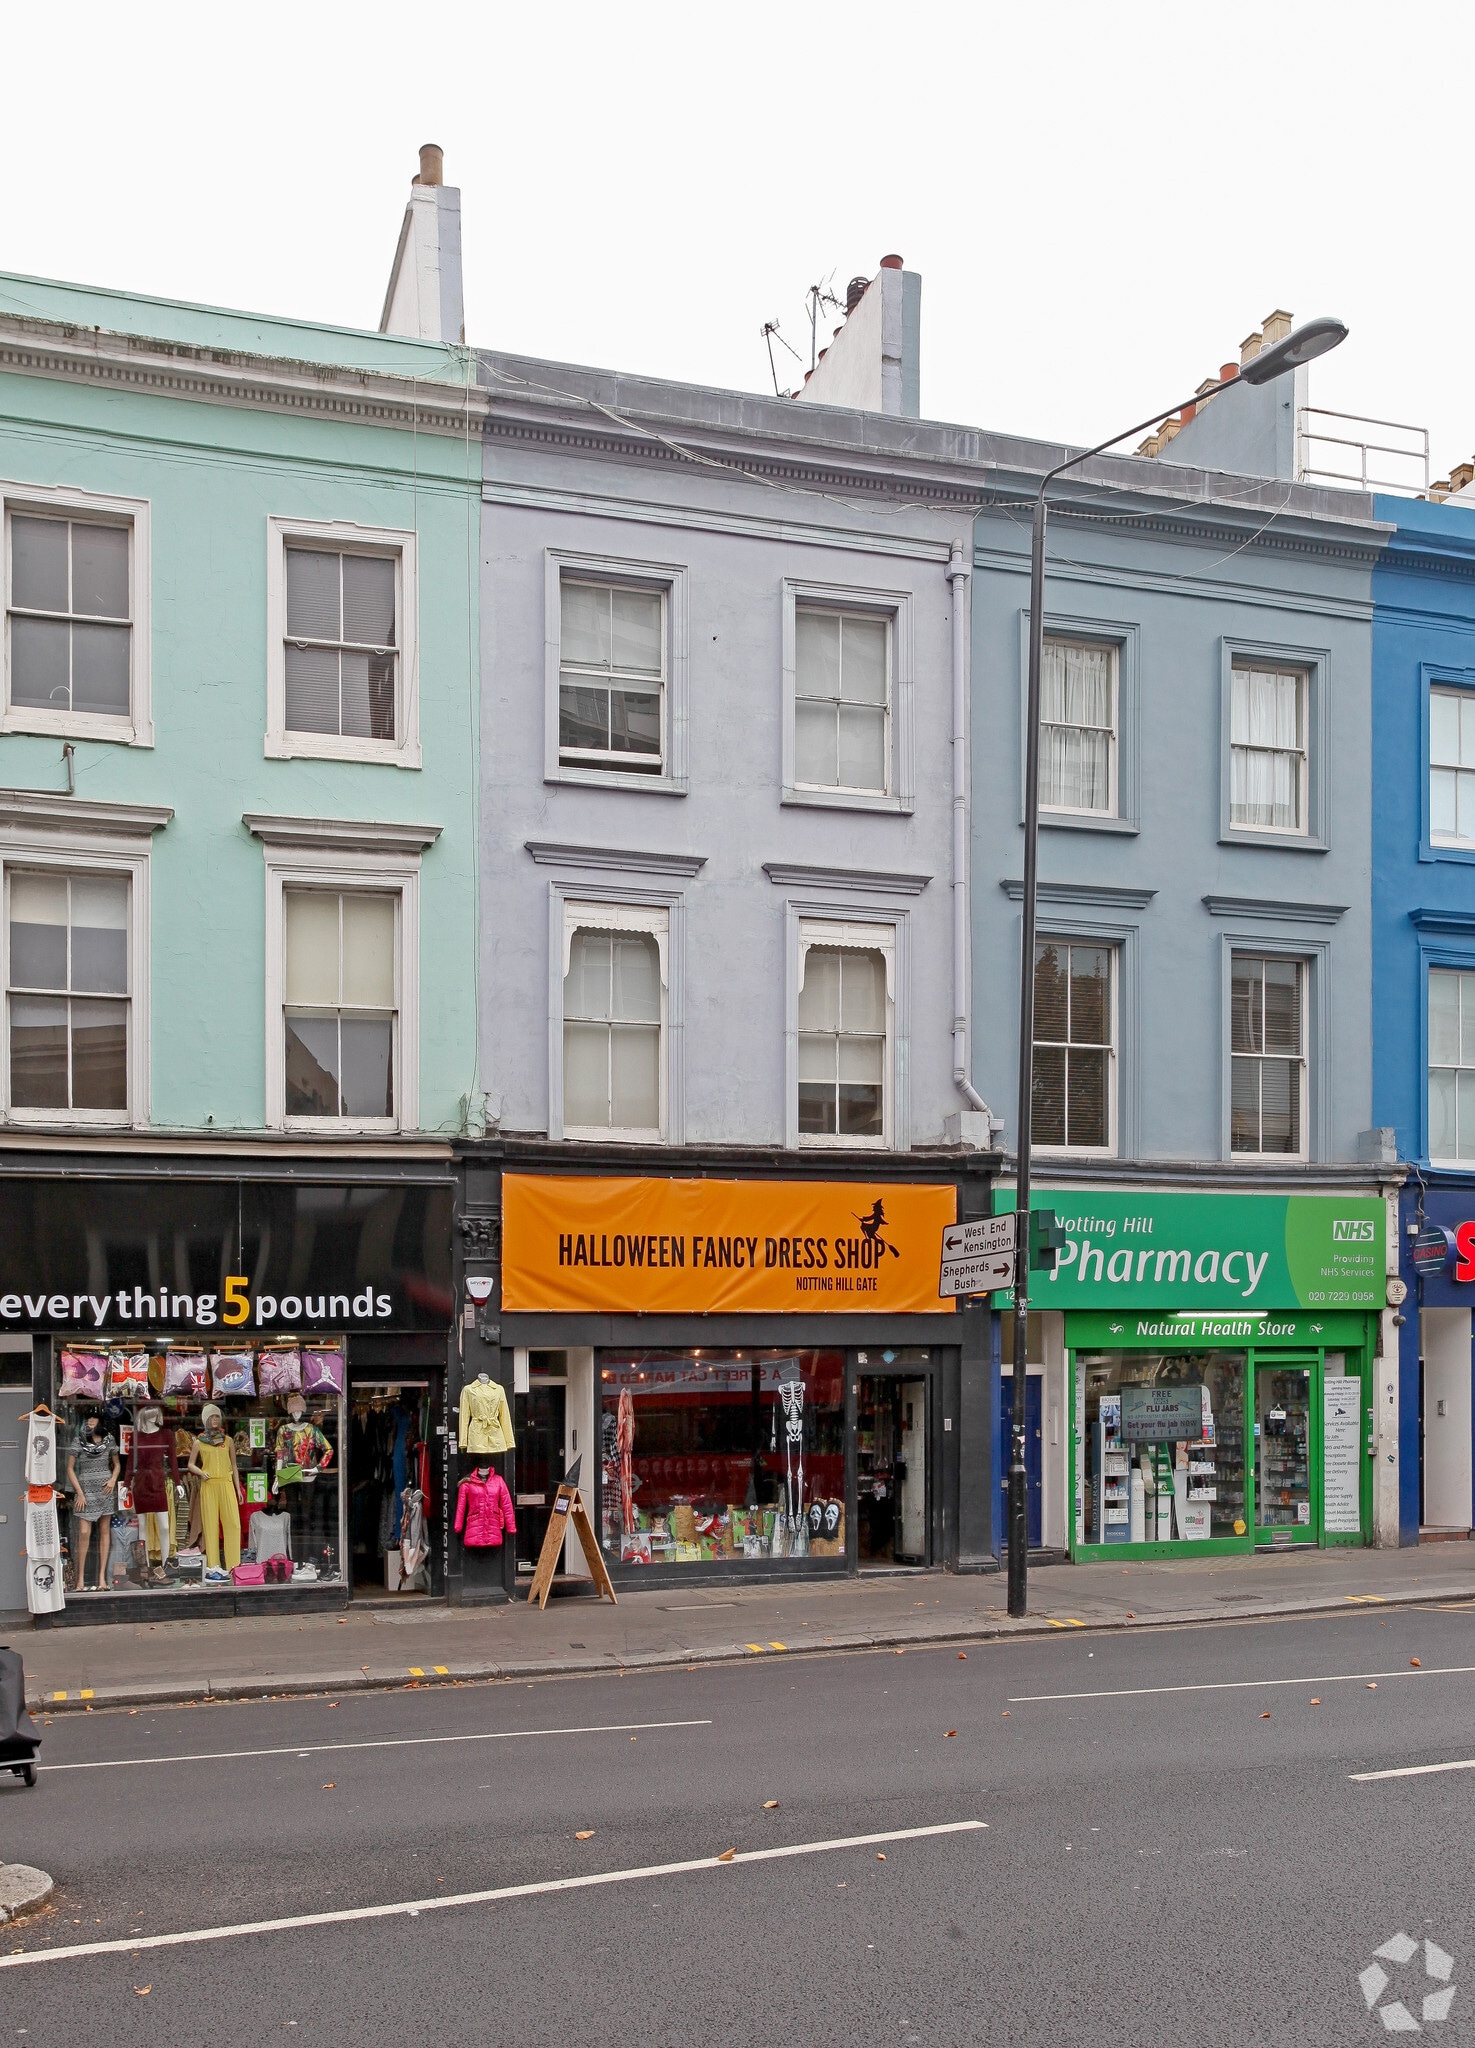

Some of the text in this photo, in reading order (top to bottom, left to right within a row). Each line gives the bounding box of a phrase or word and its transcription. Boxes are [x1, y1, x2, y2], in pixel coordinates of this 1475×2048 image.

[964, 1220, 1006, 1239] West End
[1055, 1216, 1153, 1238] Notting Hill
[1334, 1221, 1374, 1240] NHS
[558, 1233, 887, 1269] HALLOWEEN FANCY DRESS SHOP
[963, 1236, 1011, 1253] Kensington
[1413, 1245, 1448, 1260] CASINO
[1333, 1254, 1374, 1265] Providing
[943, 1261, 990, 1277] Shepherds
[1049, 1239, 1269, 1297] Pharmacy
[1320, 1267, 1375, 1277] NHS Services
[796, 1276, 878, 1292] NOTTING HILL GATE
[954, 1277, 976, 1290] Bush
[223, 1276, 250, 1326] 5
[256, 1286, 392, 1326] pounds
[1308, 1291, 1374, 1301] 020 7229 0958
[1136, 1321, 1296, 1336] Natural Health Store
[1151, 1390, 1172, 1398] FREE
[1161, 1404, 1179, 1412] JABS
[1127, 1421, 1139, 1429] Get
[1140, 1421, 1156, 1429] your
[1157, 1420, 1166, 1428] flu
[1167, 1420, 1178, 1429] jab
[249, 1480, 266, 1503] £5
